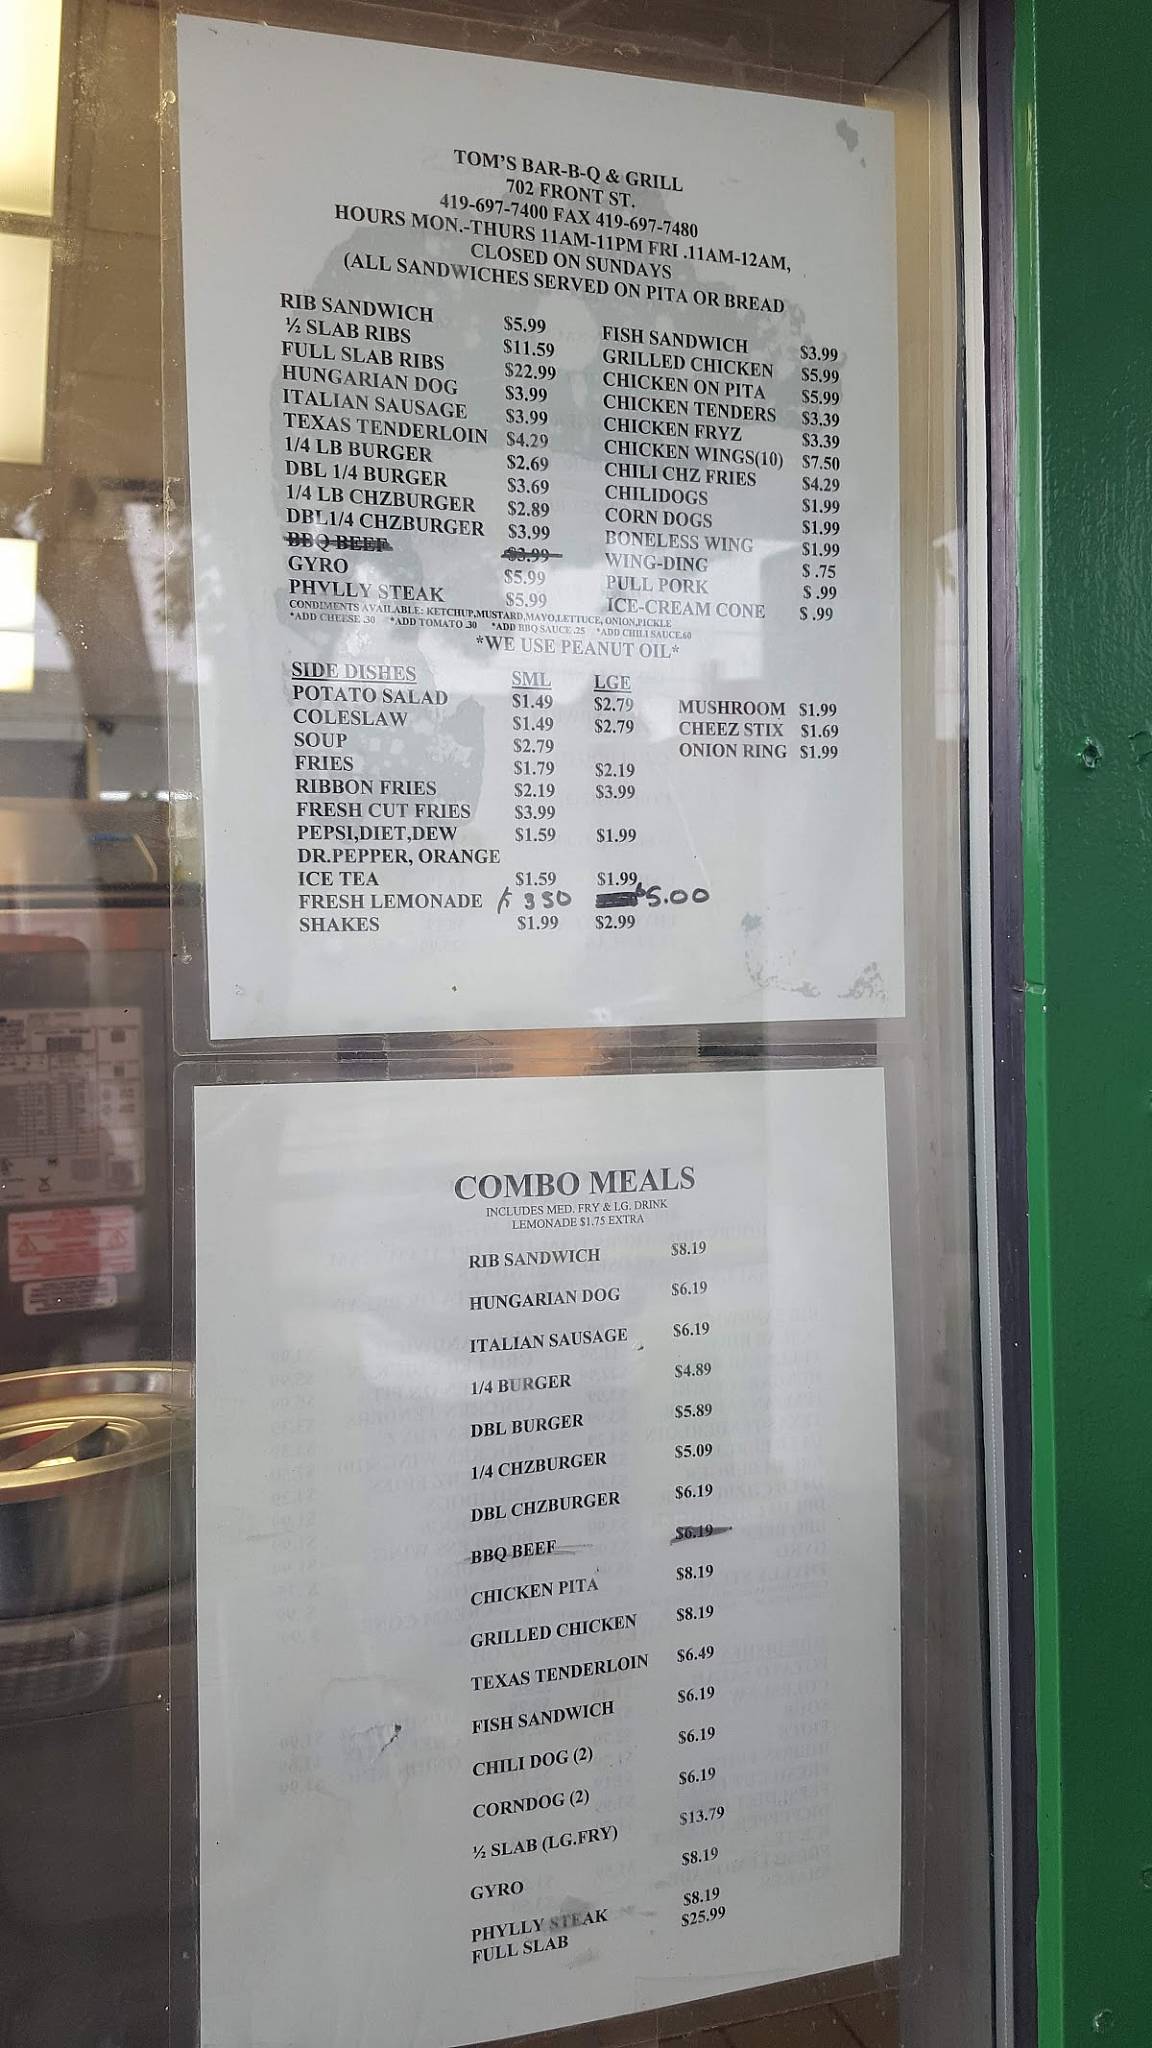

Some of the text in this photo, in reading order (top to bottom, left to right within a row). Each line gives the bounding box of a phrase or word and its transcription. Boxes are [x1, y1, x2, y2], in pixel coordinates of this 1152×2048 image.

[454, 149, 683, 192] TOM'S BAR-B-Q & GRILL
[506, 178, 635, 208] 702 FRONT ST.
[335, 204, 406, 227] HOURS
[411, 212, 548, 243] MON.-THURS
[541, 227, 642, 253] 11AM-11PM
[648, 239, 678, 257] FRI
[440, 193, 698, 238] 419-697-7400 FAX 419-697-7480
[470, 243, 672, 279] CLOSED ON SUNDAYS
[343, 251, 785, 313] (ALL SANDWICHES SERVED ON PITA OR BREAD
[280, 293, 546, 333] RIB SANDWICH $5.99
[281, 341, 556, 381] FULL SLAB RIBS $22.99
[283, 388, 548, 425] ITALIAN SAUSAGE $3.99
[603, 394, 840, 427] CHICKEN TENDERS $3.39
[604, 417, 840, 448] CHICKEN FRYZ $3.39
[285, 437, 549, 472] 1/4 LB BURGER $2.69
[285, 460, 549, 494] DBL 1/4 BURGER $3.69
[286, 484, 550, 518] 1/4 LB CHZBURGER $2.89
[605, 485, 840, 514] CHILIDOGS $1.99
[288, 555, 545, 585] GYRO $5.99
[419, 618, 463, 628] TOMATO
[521, 637, 555, 653] USE
[561, 640, 634, 657] PEANUT
[292, 661, 416, 681] SIDE DISHES
[512, 671, 631, 689] SML LGE
[679, 700, 837, 717] MUSHROOM $1.99
[679, 721, 838, 738] CHEEZ STIX $1.69
[680, 743, 838, 759] ONION RING $1.99
[295, 779, 635, 799] RIBBON FRIES $2.19 $3.99
[296, 802, 556, 820] FRESH CUT FRIES $3.99
[298, 825, 636, 843] PEPSI,DIET,DEW $1.59 $1.99
[298, 849, 500, 865] DR.PEPPER, ORANGE
[299, 894, 482, 909] FRESH LEMONADE
[454, 1166, 696, 1200] COMBO MEALS
[486, 1199, 667, 1217] INCLUDES MED. FRY & LG. DRINK
[512, 1214, 644, 1229] LEMONADE $1.75 EXTRA
[469, 1241, 706, 1268] RIB SANDWICH $8.19
[470, 1281, 707, 1310] HUNGARIAN DOG $6.19
[470, 1322, 710, 1353] ITALIAN SAUSAGE $6.19
[471, 1362, 711, 1395] 1/4 BURGER $4.89
[471, 1403, 712, 1437] DBL BURGER $5.89
[471, 1443, 713, 1479] 1/4 CHZBURGER $5.09
[471, 1483, 713, 1522] DBL CHZBURGER $6.19
[471, 1564, 714, 1606] CHICKEN PITA $8.19
[472, 1686, 715, 1734] FISH SANDWICH $6.19
[473, 1726, 715, 1777] CHILI DOG (2) $6.19
[473, 1767, 716, 1818] CORNDOG (2) $6.19
[470, 1847, 718, 1899] GYRO $8.19
[472, 1887, 720, 1942] PHYLLY STEAK $8.19
